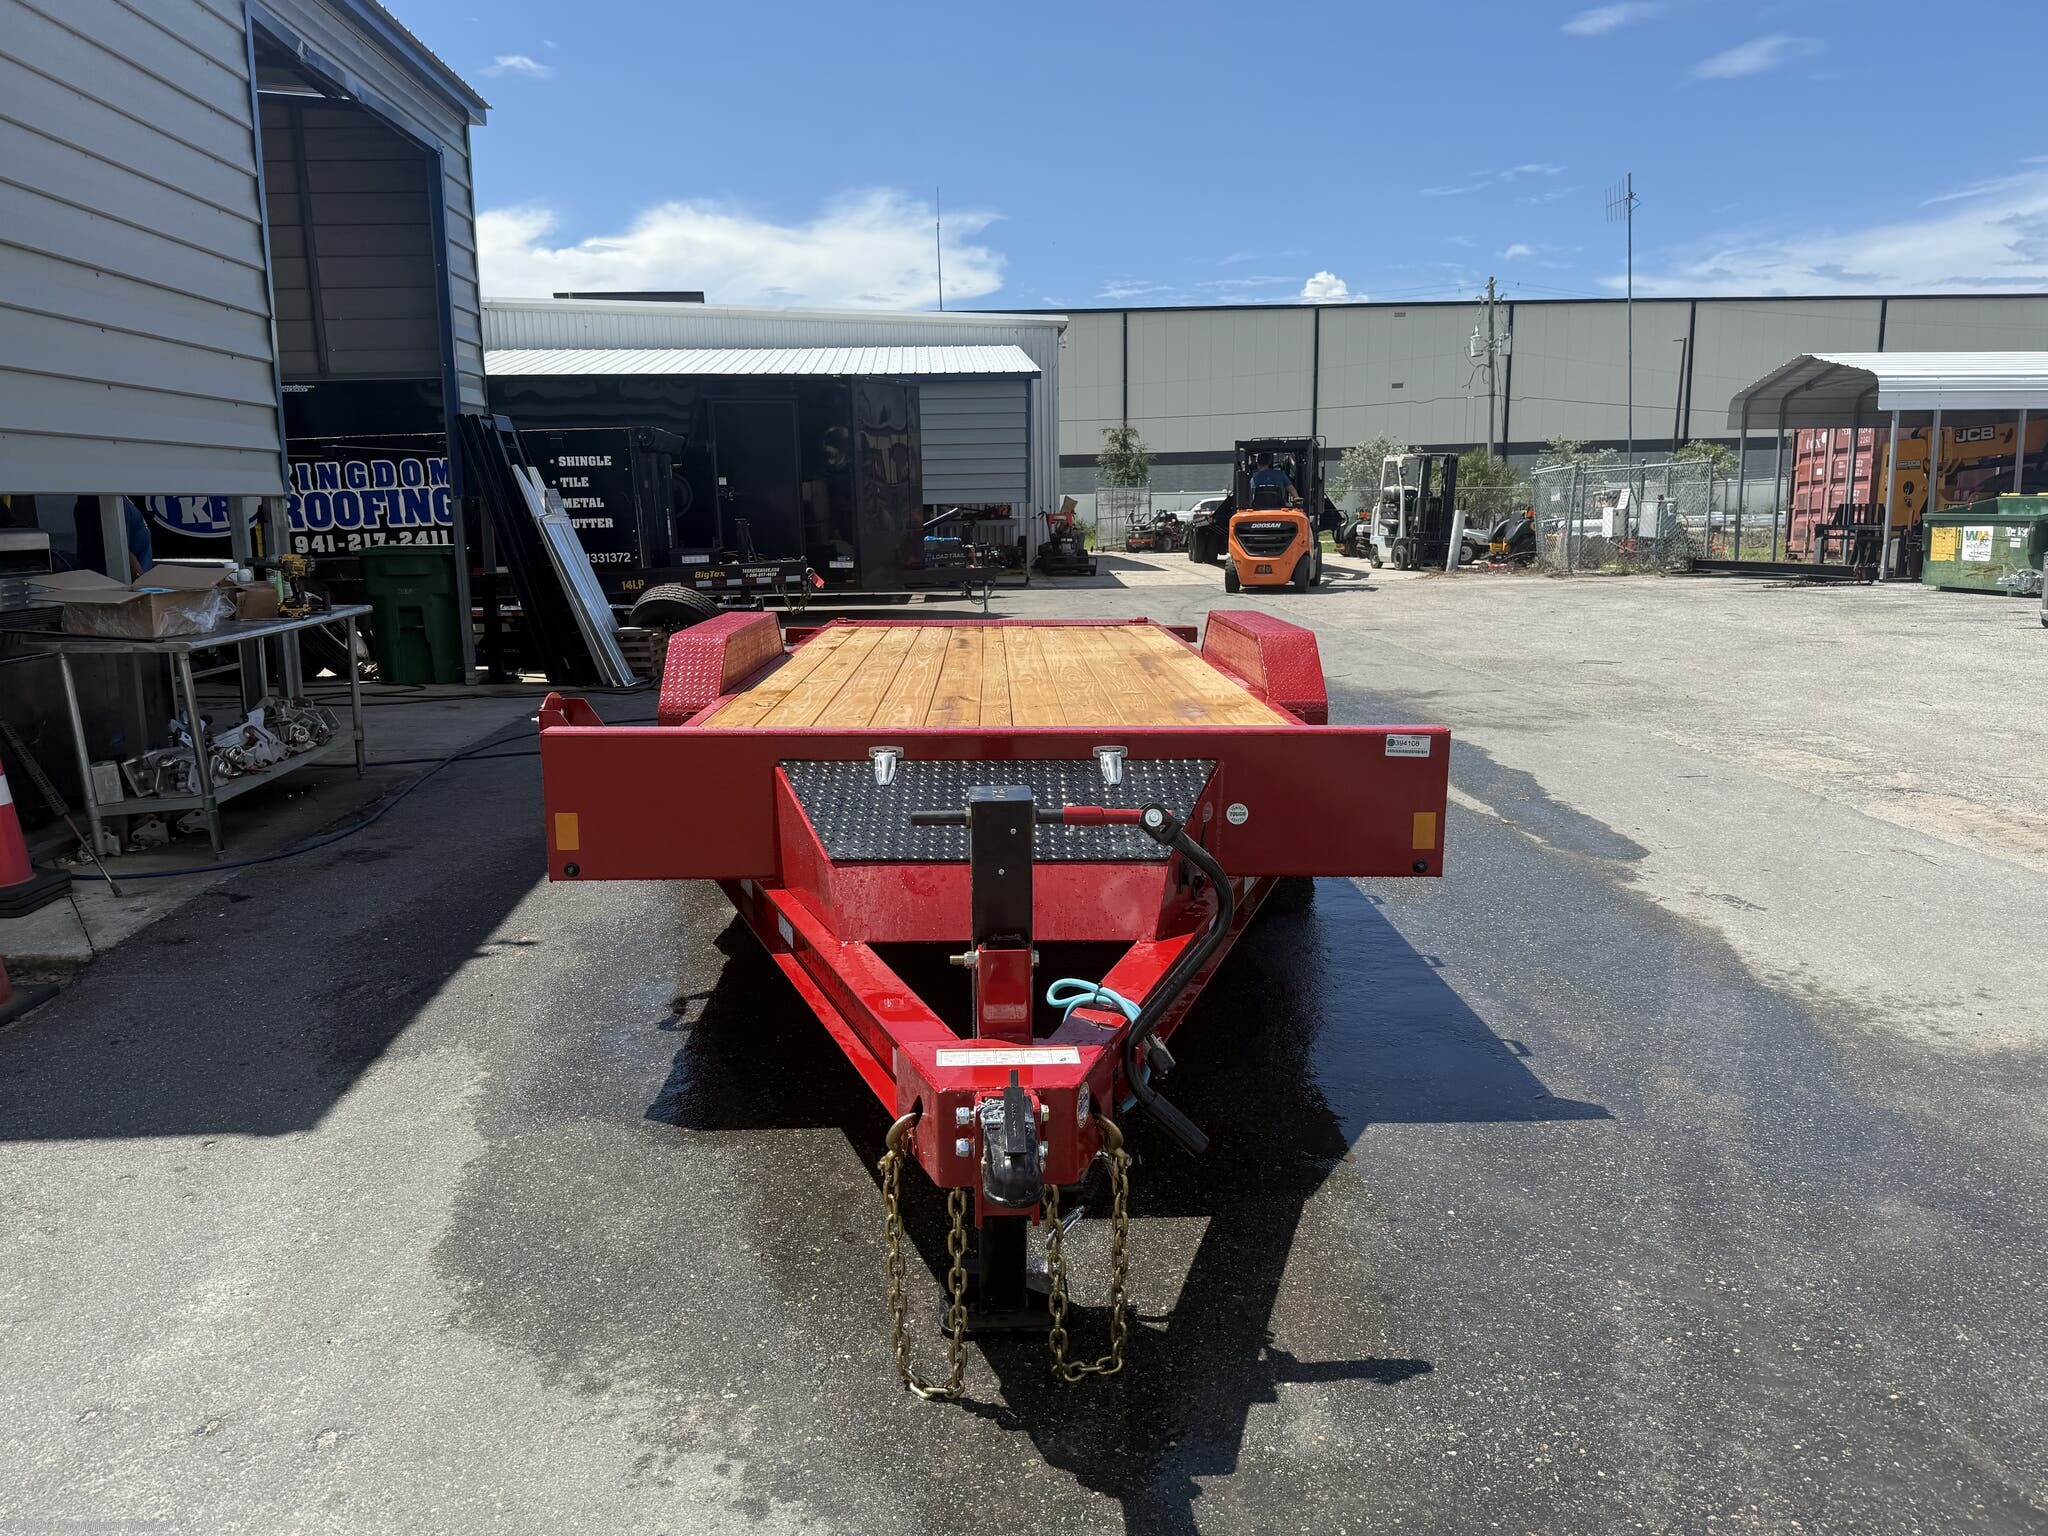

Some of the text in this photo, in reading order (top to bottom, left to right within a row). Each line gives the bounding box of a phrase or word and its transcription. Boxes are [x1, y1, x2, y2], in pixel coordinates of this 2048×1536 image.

[1956, 427, 1994, 443] JCB
[558, 455, 612, 467] SHINGLE
[560, 476, 589, 488] TILE
[562, 497, 604, 508] METAL
[286, 487, 453, 532] ROOFING
[572, 517, 614, 529] UTTER
[694, 570, 726, 580] BigTex
[621, 579, 645, 591] 14LP
